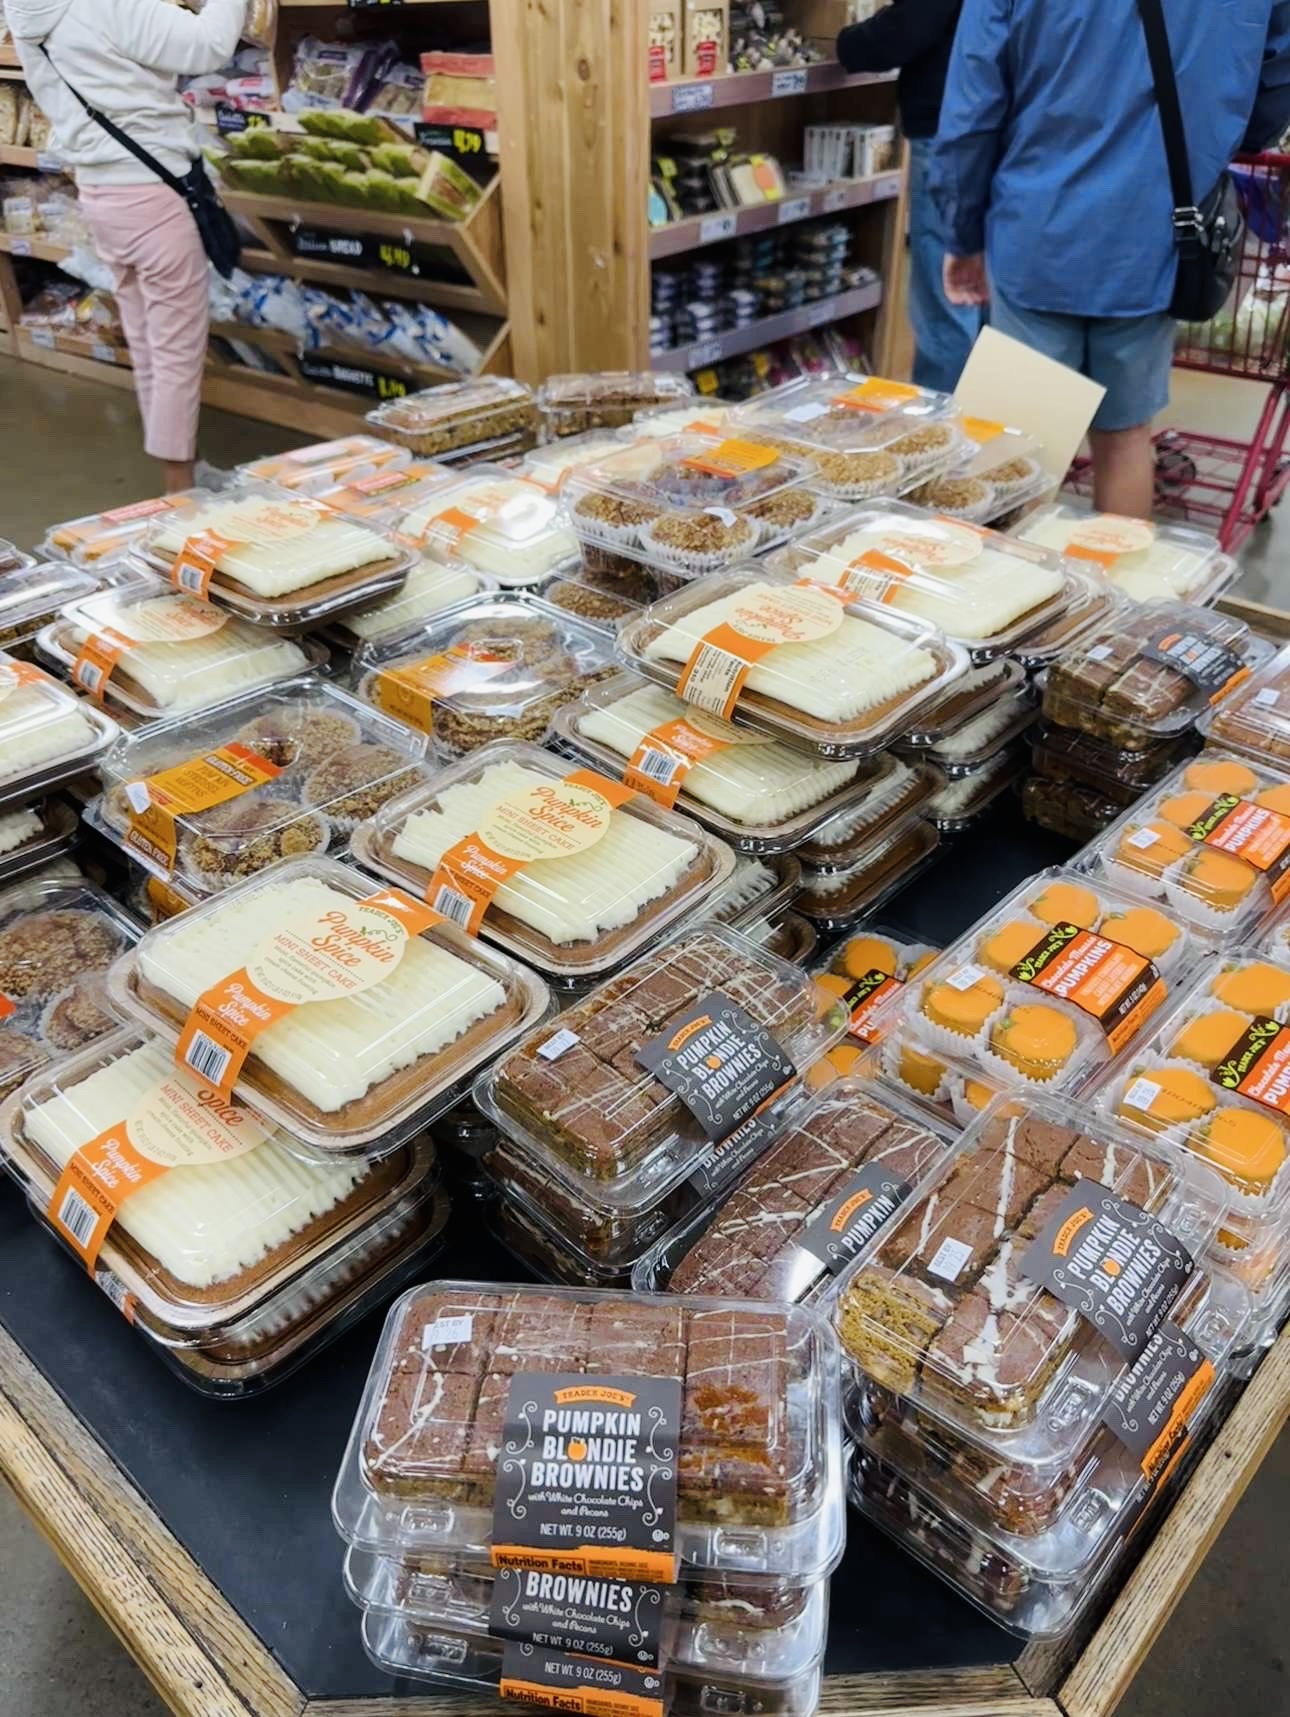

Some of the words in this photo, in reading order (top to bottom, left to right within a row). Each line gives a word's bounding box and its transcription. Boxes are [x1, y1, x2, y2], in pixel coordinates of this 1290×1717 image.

[528, 805, 576, 833] Spice
[529, 786, 603, 830] Pumpkin
[1223, 807, 1271, 853] PUMPKINS
[311, 934, 362, 967] Spice
[317, 910, 395, 963] Pumpkin
[273, 933, 300, 951] MINI
[295, 947, 331, 971] SHEET
[327, 968, 358, 990] CAKE
[1053, 940, 1114, 998] PUMPKINS
[218, 1000, 250, 1028] Spice
[223, 982, 273, 1022] Pumpkin
[209, 1015, 231, 1038] SHEET
[229, 1032, 249, 1051] CAKE
[676, 1021, 733, 1071] PUMPKIN
[702, 1043, 763, 1100] BROWNIES
[161, 1083, 183, 1102] MINI
[179, 1100, 209, 1129] SHEET
[207, 1128, 234, 1153] CAKE
[91, 1161, 120, 1189] Spice
[100, 1137, 143, 1183] Pumpkin
[99, 1195, 115, 1215] CAKE
[841, 1194, 896, 1254] PUMPKIN
[1067, 1214, 1121, 1280] PUMPKIN
[1106, 1239, 1161, 1317] BROWNIES
[563, 1389, 598, 1399] TRADER
[600, 1390, 626, 1401] JOE'S
[1147, 1411, 1159, 1426] NET
[1166, 1386, 1175, 1400] OZ
[542, 1409, 641, 1437] PUMPKIN
[530, 1461, 644, 1492] BROWNIES
[528, 1491, 546, 1501] with
[545, 1490, 573, 1504] White
[573, 1492, 617, 1506] Chocolate
[617, 1495, 643, 1510] Chips
[561, 1506, 578, 1516] and
[578, 1505, 609, 1518] Pecans
[540, 1523, 560, 1536] NET
[560, 1523, 574, 1537] WT.
[575, 1524, 582, 1537] 9
[584, 1525, 597, 1539] OZ
[598, 1526, 627, 1543] (255g)
[499, 1555, 549, 1570] Nutrition
[551, 1558, 583, 1572] Facts
[525, 1571, 633, 1613] BROWNIES
[522, 1602, 540, 1613] with
[539, 1603, 565, 1617] White
[564, 1607, 606, 1624] Chocolate
[605, 1615, 631, 1631] Chips
[552, 1619, 569, 1630] and
[568, 1620, 598, 1635] Pecans
[532, 1631, 550, 1643] NET
[550, 1634, 562, 1647] WT.
[565, 1637, 572, 1648] 9
[573, 1638, 586, 1651] OZ
[586, 1640, 614, 1657] (255g)
[545, 1661, 561, 1675] NET
[561, 1663, 574, 1676] WT.
[575, 1664, 583, 1677] 9
[584, 1666, 595, 1680] OZ
[596, 1668, 622, 1686] (255g)
[506, 1688, 550, 1705] Nutrition
[552, 1694, 582, 1712] Facts
